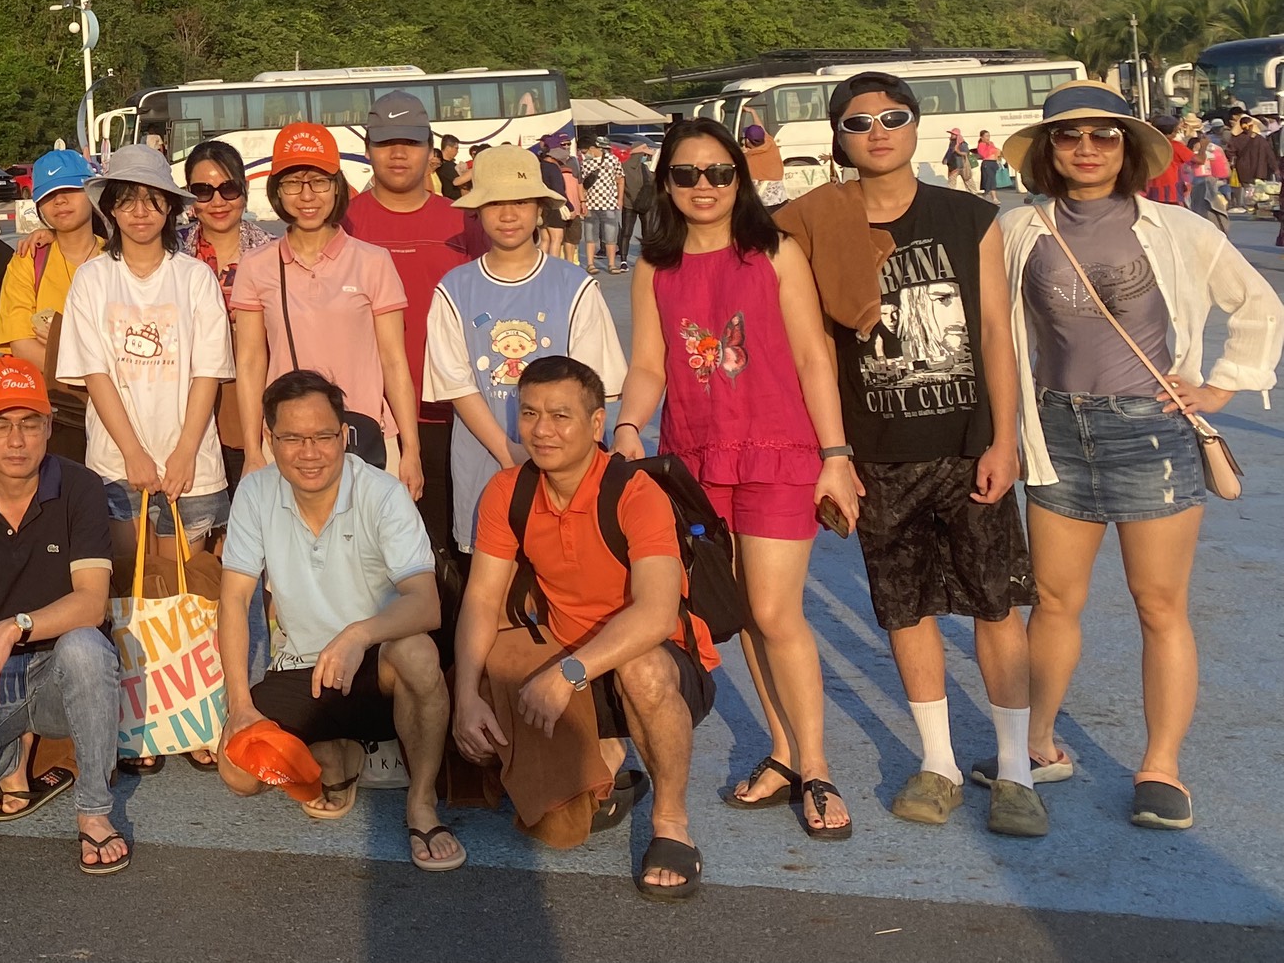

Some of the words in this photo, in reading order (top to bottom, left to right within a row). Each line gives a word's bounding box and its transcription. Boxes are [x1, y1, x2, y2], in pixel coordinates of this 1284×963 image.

[878, 243, 957, 295] RVANA
[1, 378, 29, 390] Tour
[866, 388, 908, 413] CITY
[918, 380, 978, 409] CYCLE
[119, 635, 224, 724] T.IVE
